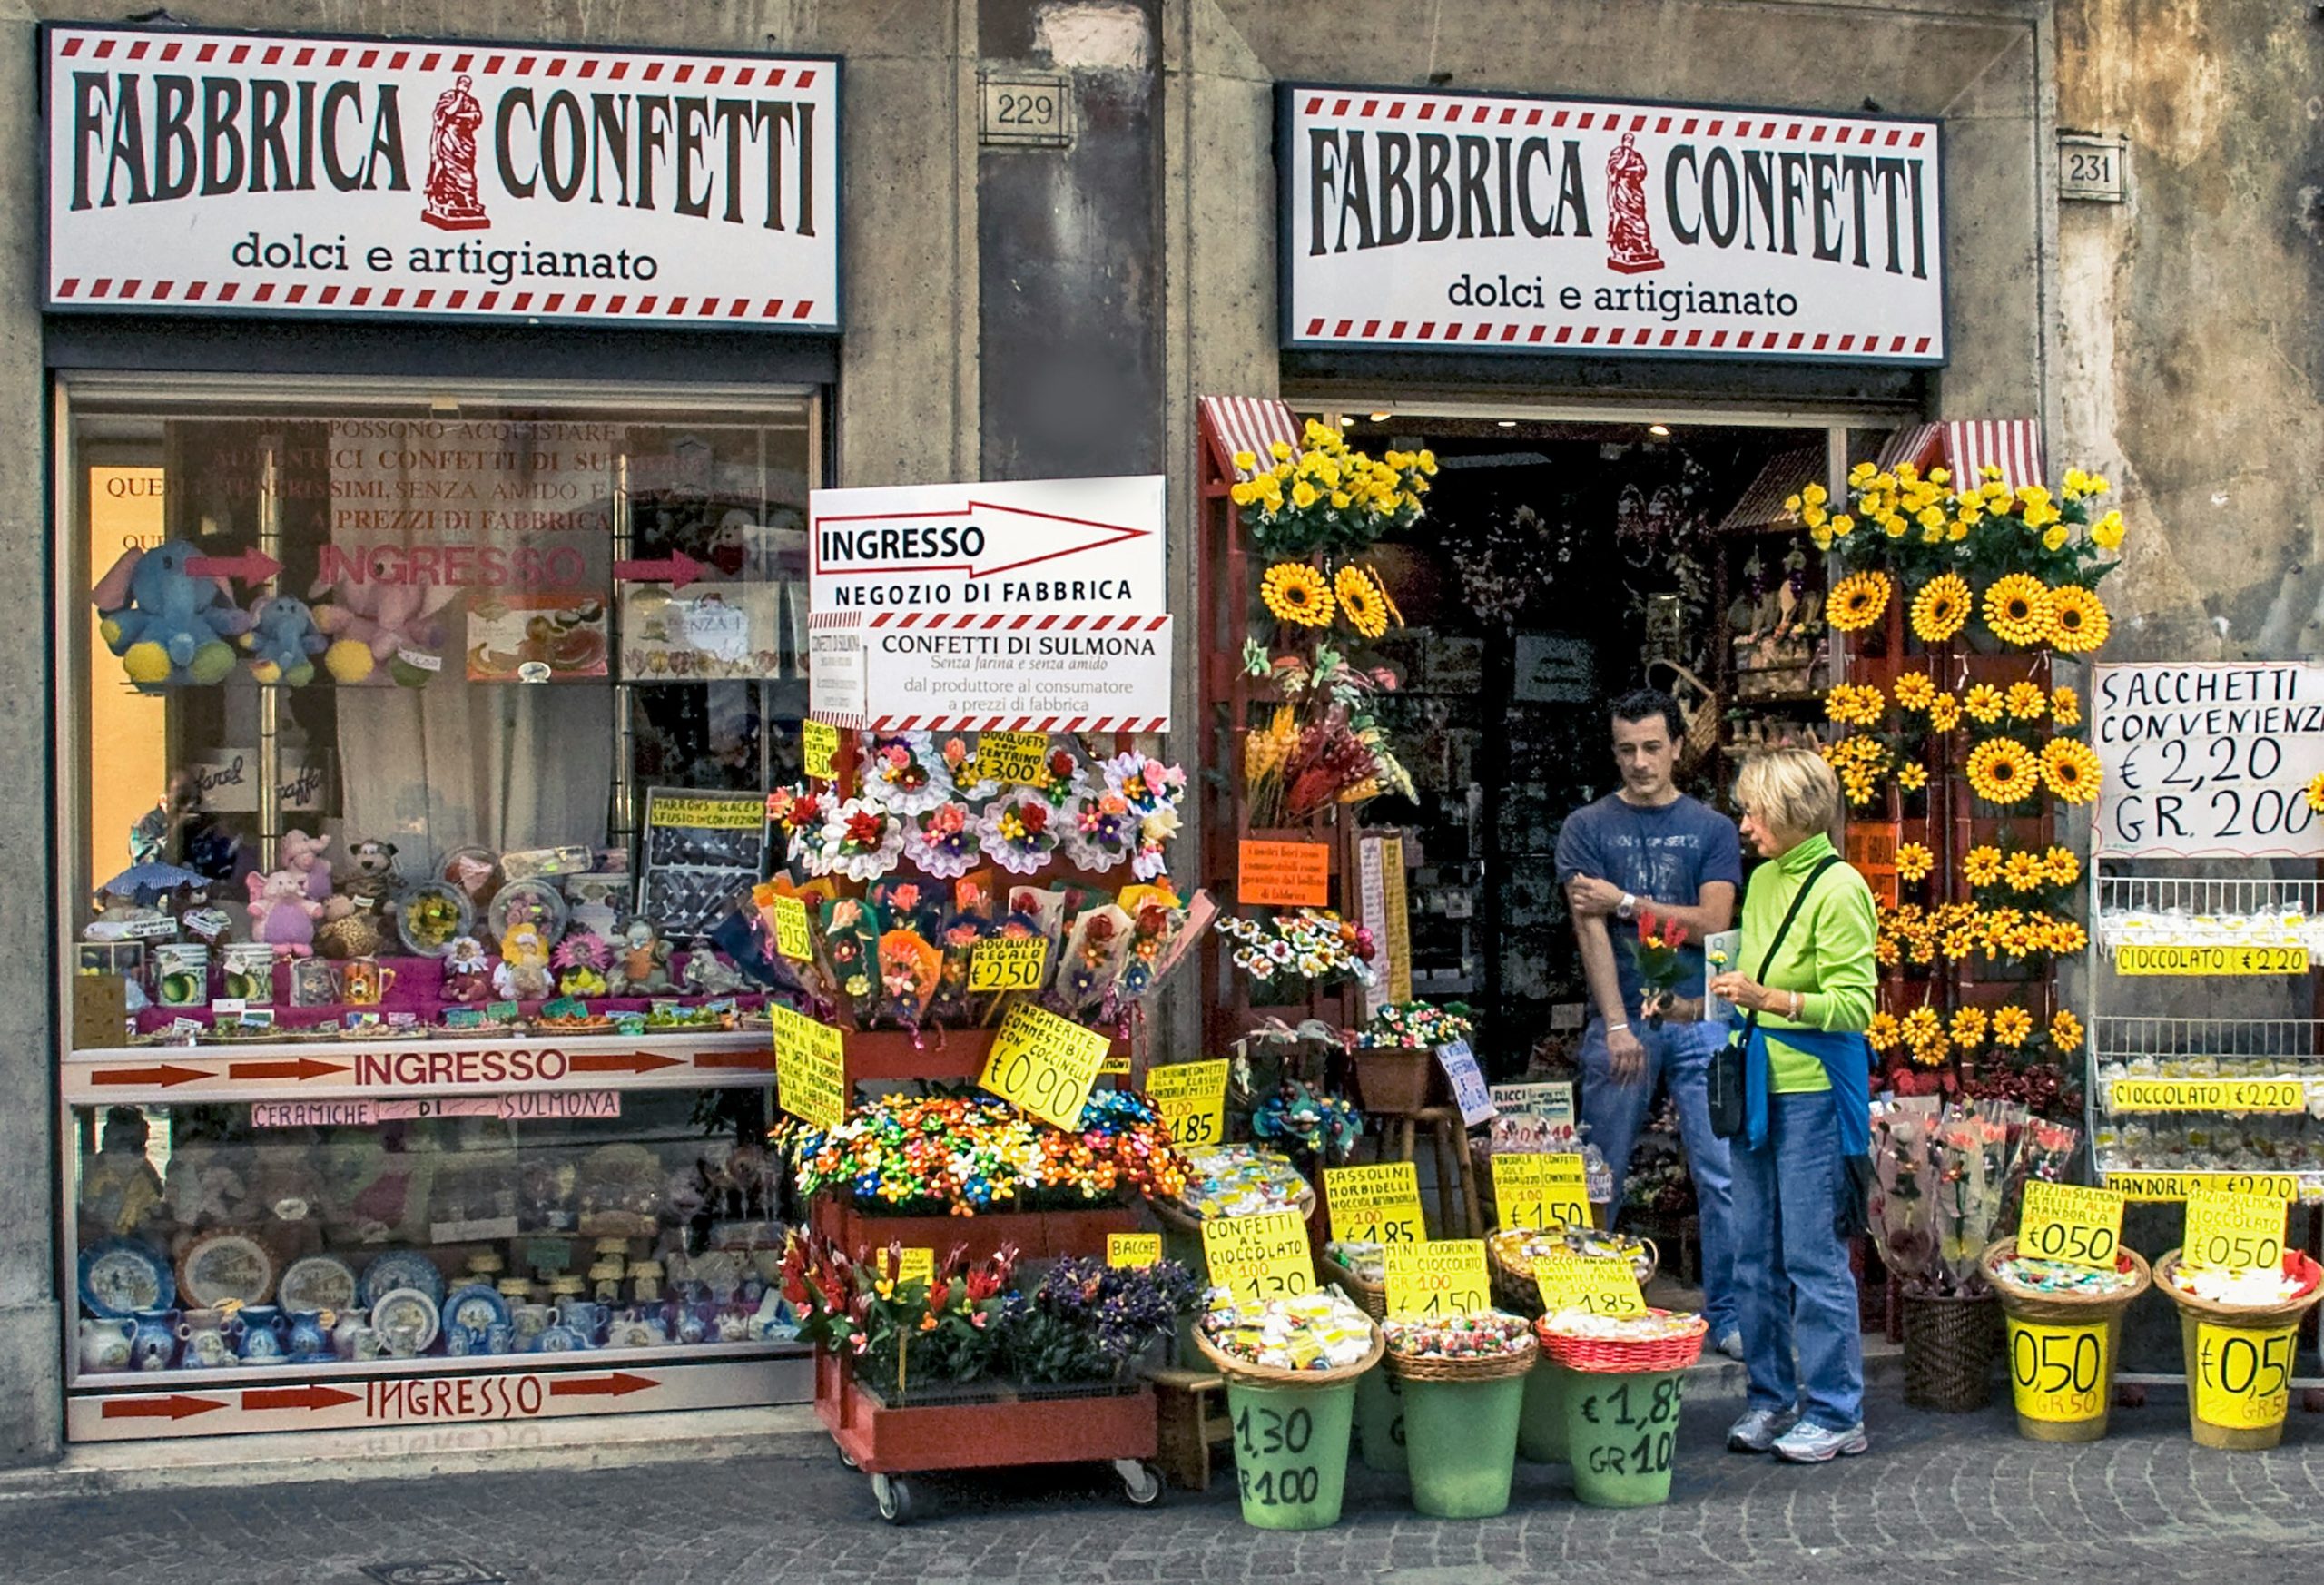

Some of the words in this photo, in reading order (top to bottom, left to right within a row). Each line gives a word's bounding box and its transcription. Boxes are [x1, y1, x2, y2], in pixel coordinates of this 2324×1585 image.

[999, 94, 1052, 124] 229
[70, 70, 411, 212] FABBRICA
[495, 86, 816, 239] CONFETTI
[2070, 154, 2110, 182] 231
[1308, 128, 1592, 257] FABBRICA
[1663, 143, 1928, 280] CONFETTI
[231, 232, 349, 271] dolci
[366, 246, 394, 271] e
[409, 241, 659, 285] artigianato
[1448, 273, 1542, 310] dolci
[1559, 289, 1582, 310] e
[1593, 283, 1798, 320] artigianato
[330, 419, 445, 439] POSSONO
[460, 422, 616, 443] ACQUISTARE
[379, 448, 517, 471] CONFETTI
[533, 452, 558, 471] DI
[396, 479, 477, 499] SENZA
[492, 481, 577, 500] AMIDO
[337, 510, 433, 531] PREZZI
[442, 510, 470, 531] DI
[482, 511, 611, 532] FABBRICA
[822, 527, 985, 562] INGRESSO
[320, 546, 586, 586] INGRESSO
[835, 585, 951, 605] NEGOZIO
[965, 583, 990, 603] DI
[1003, 580, 1132, 603] FABBRICA
[882, 635, 999, 655] CONFETTI
[1009, 636, 1032, 655] DI
[1039, 637, 1156, 656] SULMONA
[931, 655, 970, 671] Senza
[974, 655, 1013, 673] farina
[1018, 660, 1026, 671] e
[1029, 659, 1064, 672] senza
[1068, 657, 1108, 672] amido
[904, 678, 927, 693] dal
[932, 679, 1013, 697] produttore
[1018, 679, 1031, 693] al
[1035, 680, 1133, 694] consumatore
[2102, 669, 2297, 710] SACCHETTI
[949, 700, 958, 711] a
[961, 698, 1008, 715] prezzi
[1011, 697, 1026, 712] di
[1029, 697, 1090, 713] fabbrica
[2102, 706, 2324, 743] CONVENIENZ
[981, 730, 1046, 748] BOUQUETS
[979, 746, 1041, 765] CENTRINO
[2211, 789, 2313, 837] 200
[974, 939, 1043, 950] BOUQUETS
[975, 950, 1040, 960] REGALO
[2119, 948, 2224, 970] CIOCCOLATO
[1011, 1002, 1098, 1050] MARGHERITE
[1004, 1015, 1095, 1065] COMMESTIBILI
[1000, 1029, 1025, 1047] CON
[1030, 1044, 1092, 1084] COCCINELLA
[354, 1049, 567, 1088] INGRESSO
[1494, 1089, 1526, 1102] RICCI
[2116, 1084, 2220, 1105] CIOCCOLATO
[254, 1104, 367, 1127] CERAMICHE
[419, 1101, 442, 1116] DI
[505, 1092, 617, 1117] SULMONA
[1166, 1101, 1193, 1117] 100
[1327, 1167, 1410, 1186] SASSOLINI
[1329, 1181, 1410, 1198] MORBIDELLI
[1518, 1189, 1543, 1201] 100
[1354, 1208, 1383, 1225] 100
[2031, 1206, 2108, 1223] MANDORLA
[2085, 1201, 2116, 1214] ALLA
[1206, 1214, 1294, 1240] CONFETTI
[2188, 1207, 2281, 1233] CIOCCOLATO
[1112, 1240, 1157, 1256] BACCHE
[1210, 1239, 1303, 1265] CIOCCOLATO
[1240, 1236, 1261, 1246] AL
[1385, 1244, 1419, 1257] MINI
[1428, 1243, 1479, 1256] CUORICINI
[1238, 1261, 1270, 1278] 100
[1388, 1258, 1406, 1271] AL
[1417, 1256, 1483, 1272] CIOCCOLATO
[1416, 1274, 1452, 1291] 100
[367, 1375, 542, 1418] INGRESSO
[1589, 1446, 1625, 1475] GR
[1630, 1431, 1673, 1474] 10
